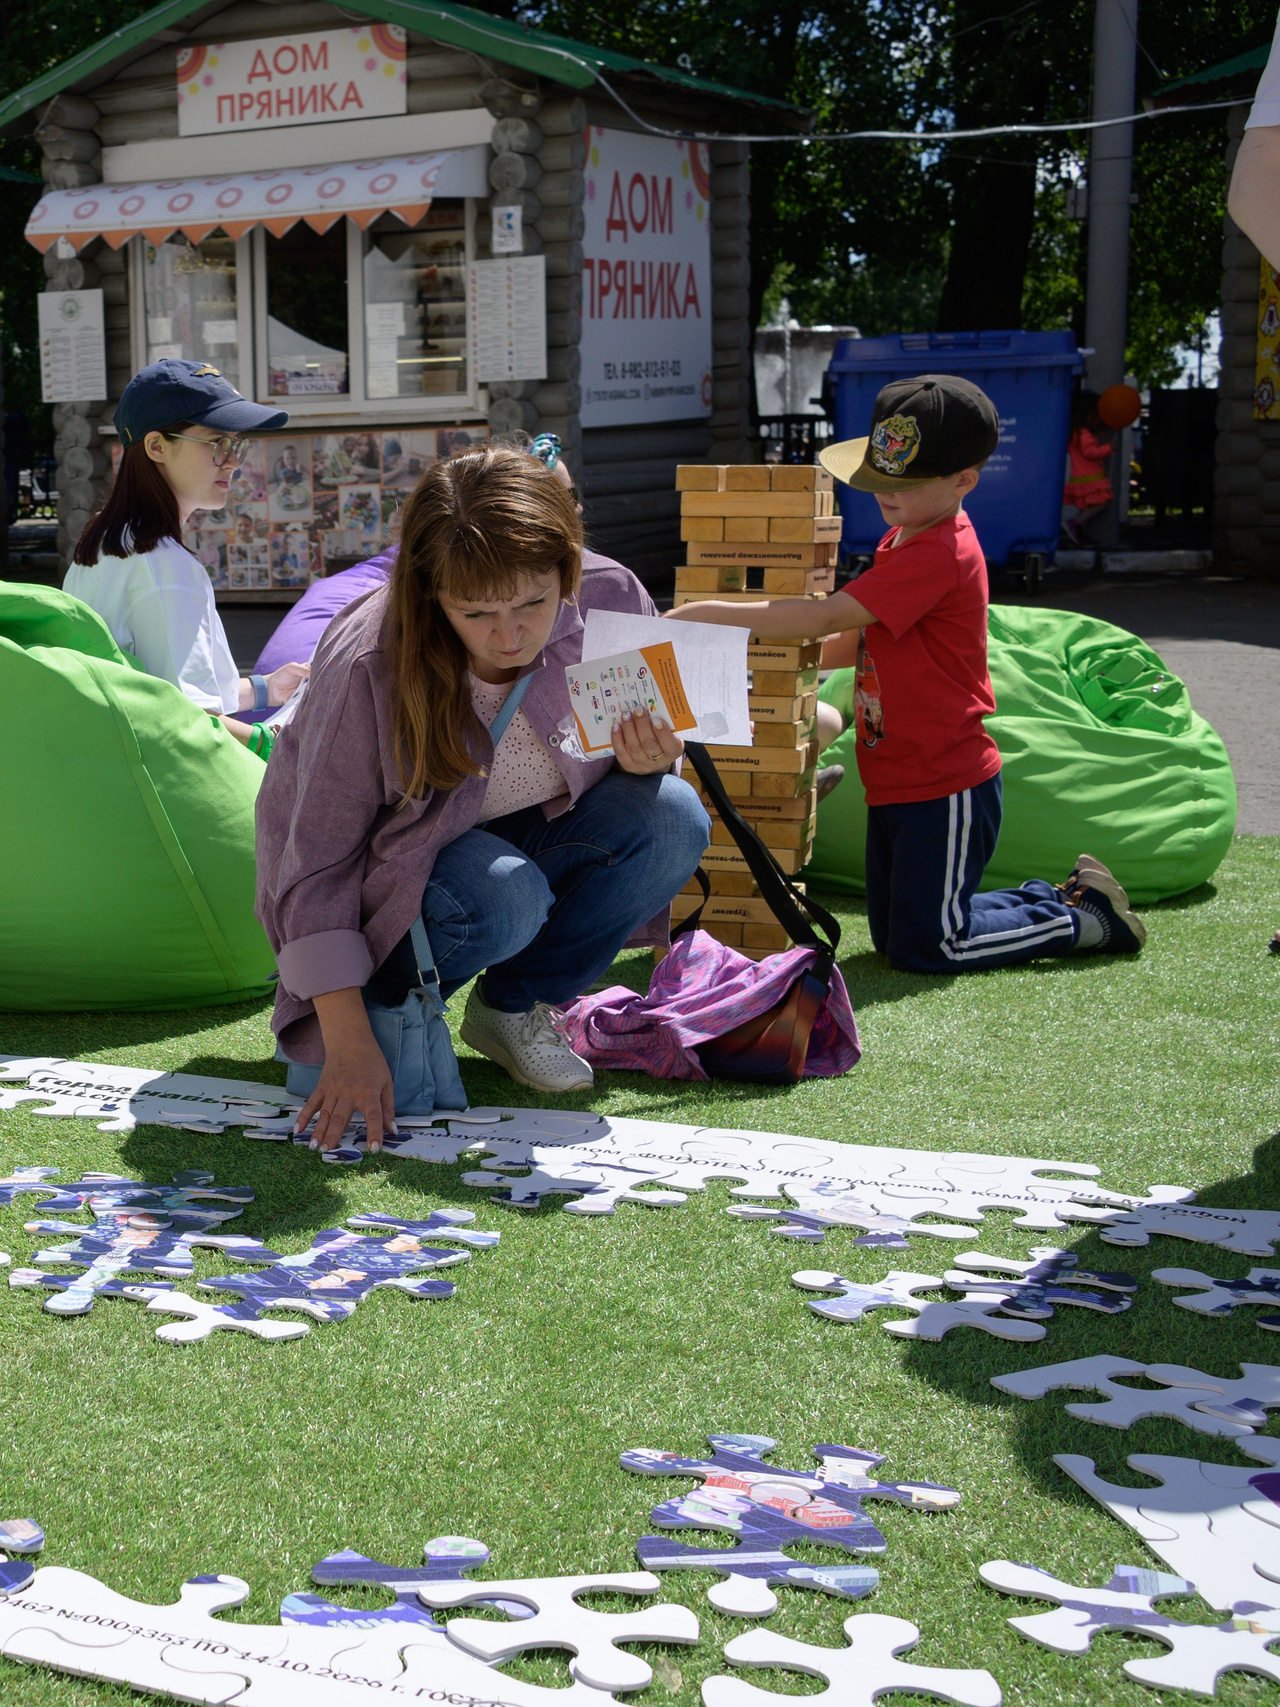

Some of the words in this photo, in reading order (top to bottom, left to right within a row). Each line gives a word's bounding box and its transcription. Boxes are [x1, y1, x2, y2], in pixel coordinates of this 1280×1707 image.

[247, 41, 330, 84] ДОМ
[216, 80, 364, 124] ПРЯНИКА
[606, 170, 674, 243] ДОМ
[580, 258, 701, 319] ПРЯНИКА
[711, 909, 747, 917] Турагент
[22, 1086, 146, 1104] SKILLCITY
[38, 1076, 132, 1095] Город
[769, 1169, 814, 1179] при
[1120, 1198, 1247, 1225] Мегафон
